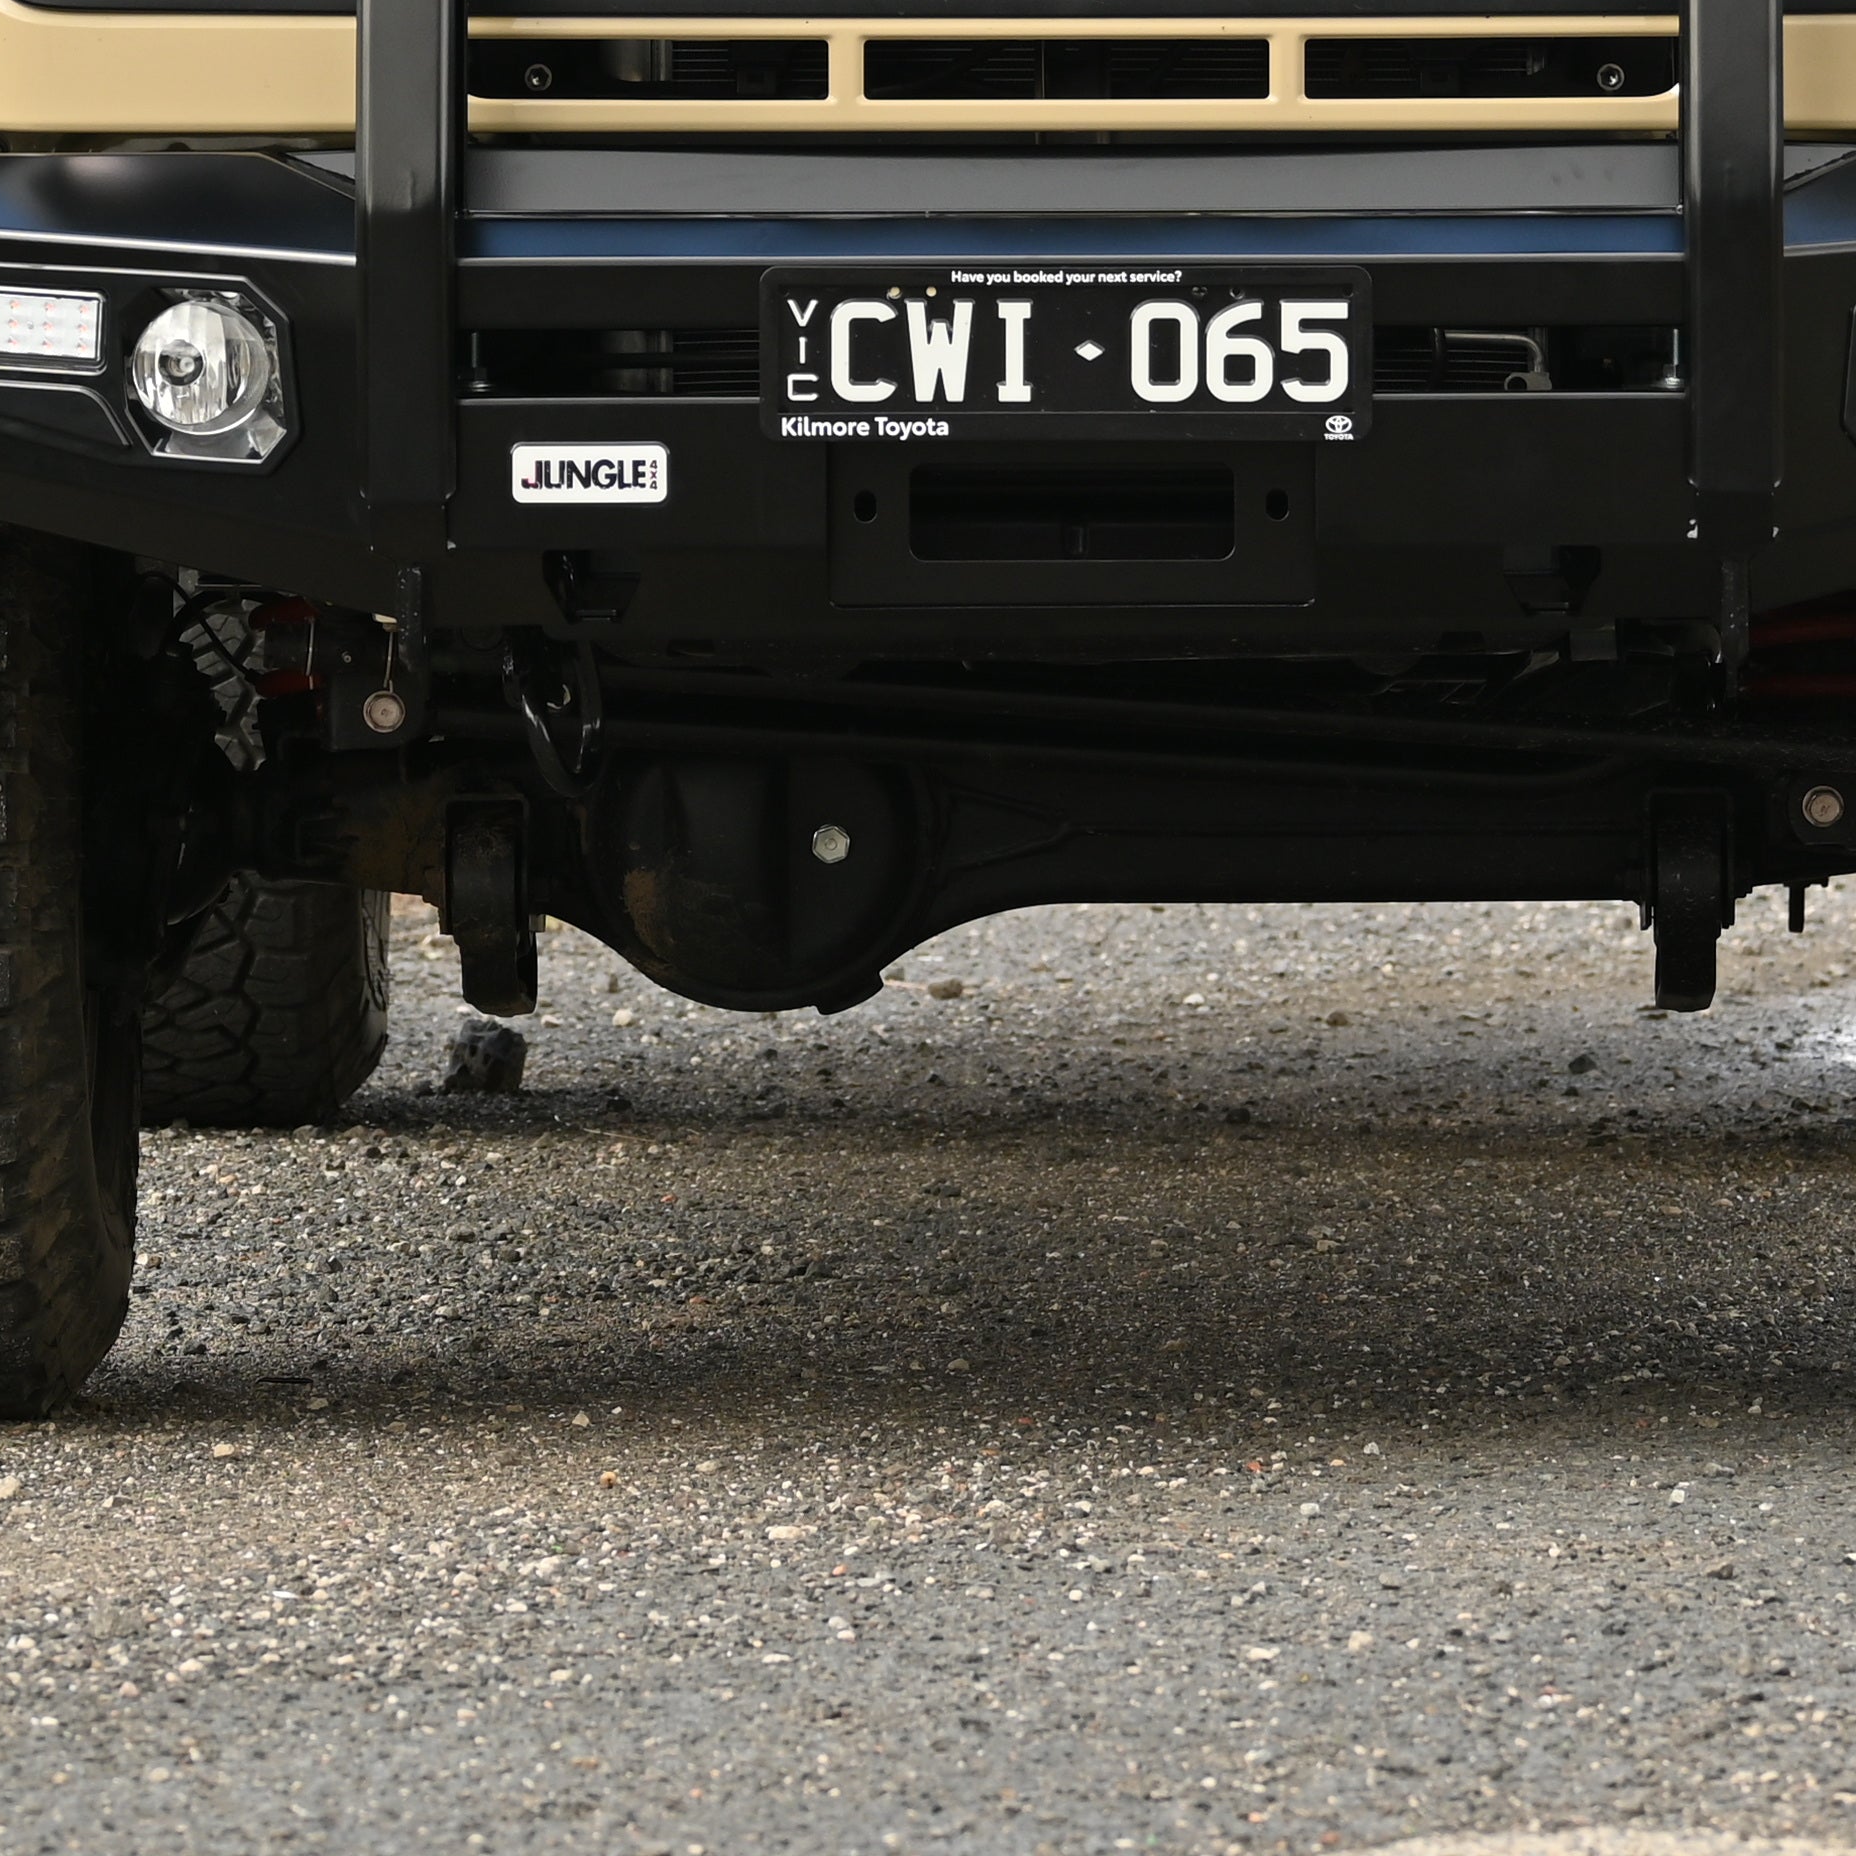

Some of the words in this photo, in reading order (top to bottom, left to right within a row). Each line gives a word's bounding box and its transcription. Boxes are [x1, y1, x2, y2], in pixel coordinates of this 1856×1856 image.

[951, 270, 983, 282] Have
[986, 274, 1010, 285] you
[1013, 270, 1063, 283] booked
[1065, 274, 1095, 285] your
[1098, 272, 1127, 282] next
[1129, 270, 1182, 282] service?
[787, 299, 819, 401] VIC
[831, 299, 1034, 402] CWI
[1130, 299, 1349, 402] 065
[781, 416, 870, 437] Kilmore
[874, 416, 949, 441] Toyota
[521, 460, 646, 489] JUNGLE
